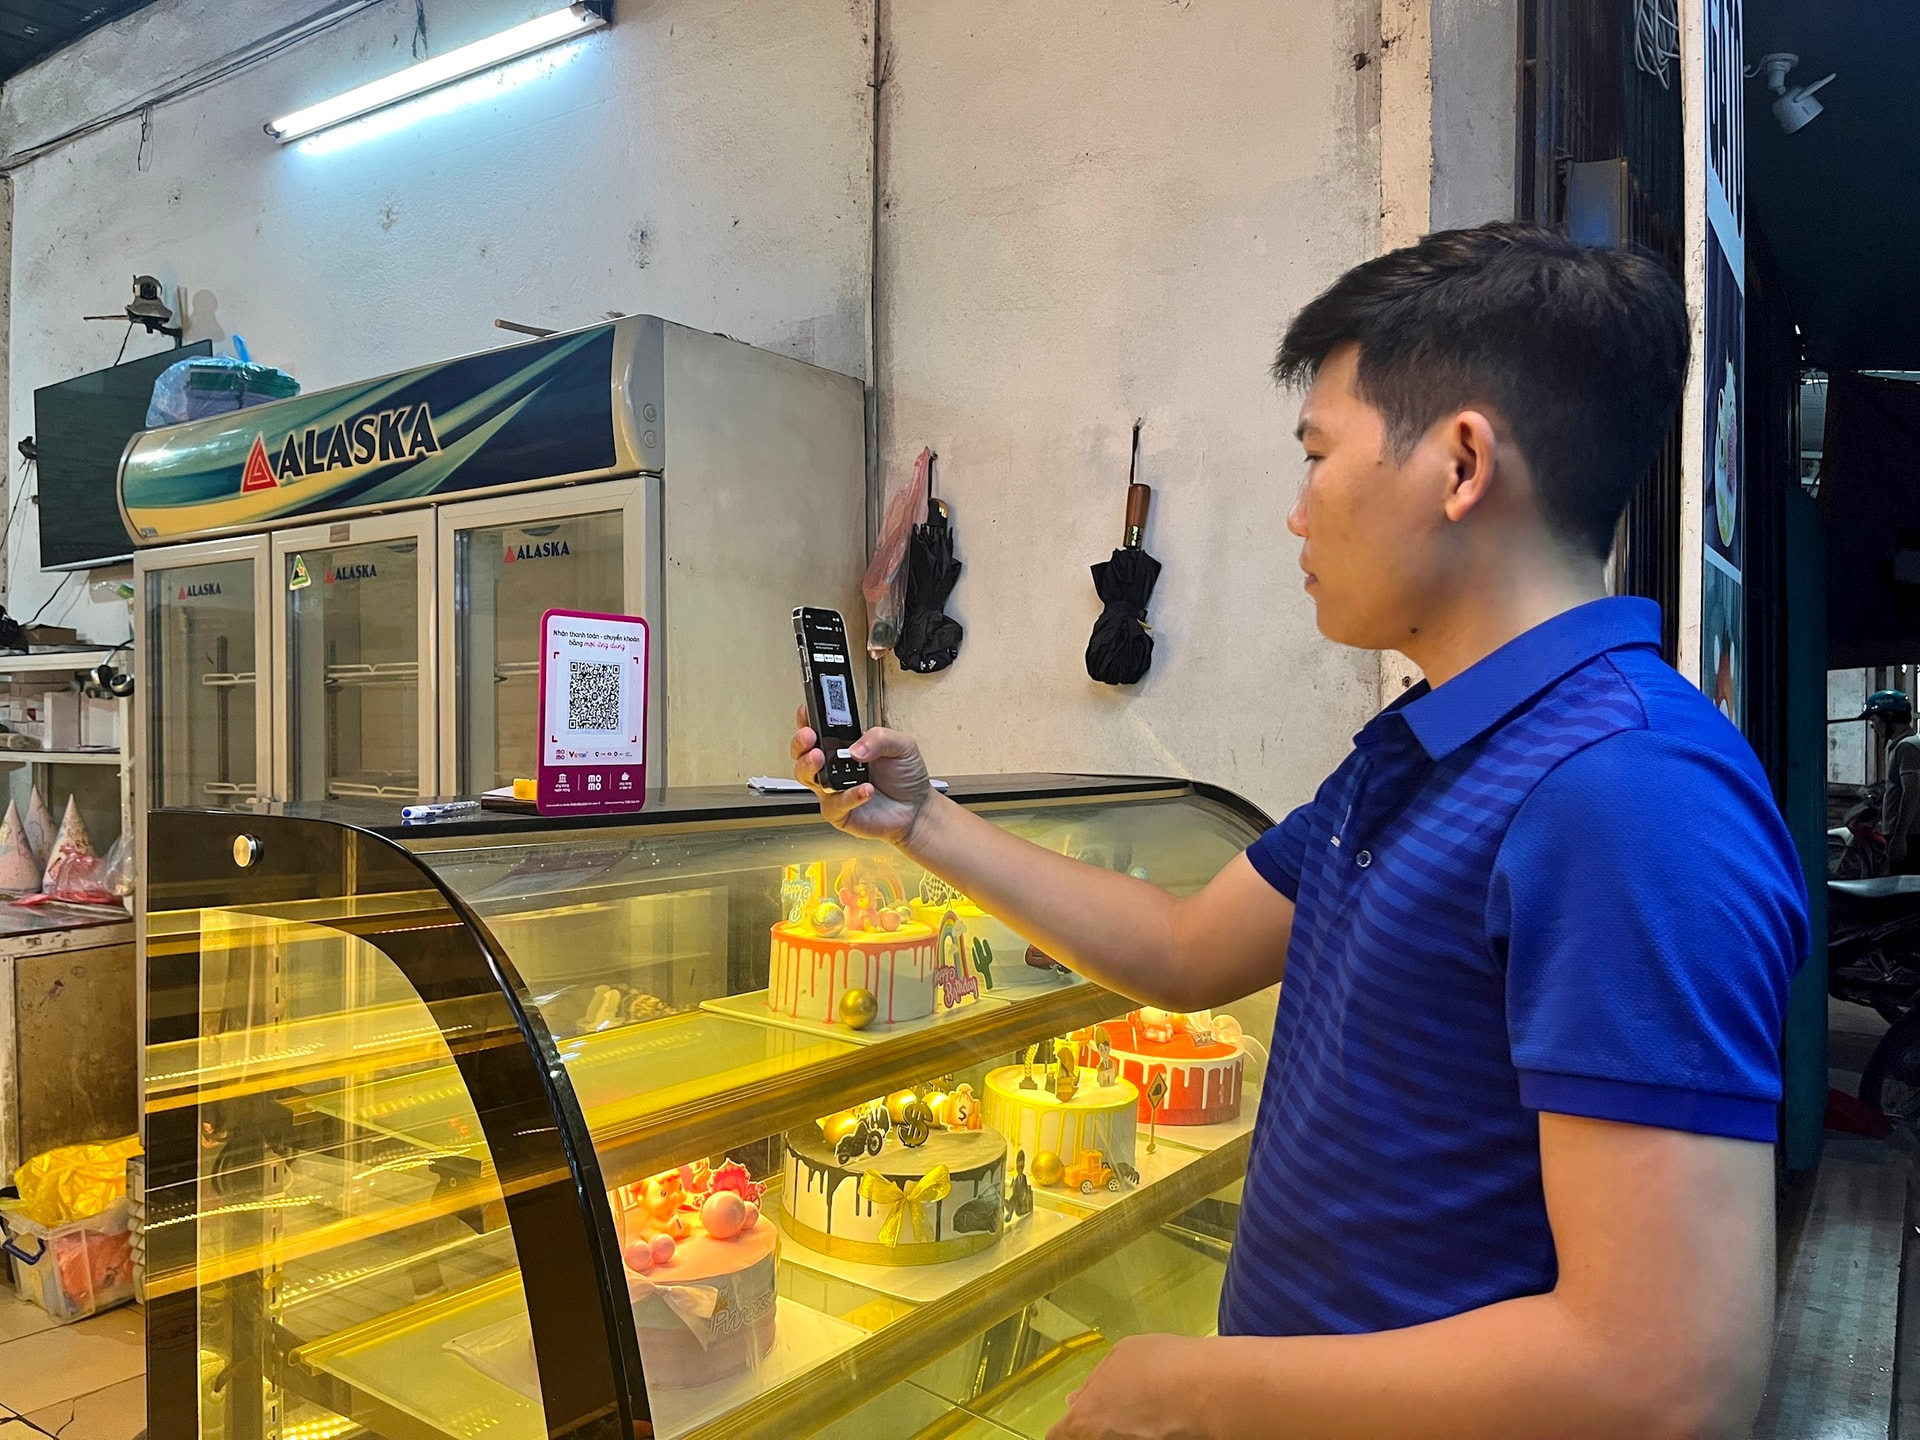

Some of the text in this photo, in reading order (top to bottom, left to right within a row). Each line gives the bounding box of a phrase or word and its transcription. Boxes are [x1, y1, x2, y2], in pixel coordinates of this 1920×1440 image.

[277, 403, 441, 481] ALASKA
[516, 541, 571, 561] ALASKA
[335, 564, 378, 581] ALASKA
[186, 583, 222, 597] ALASKA
[944, 976, 979, 1008] Birthday
[711, 1290, 772, 1335] Princess
